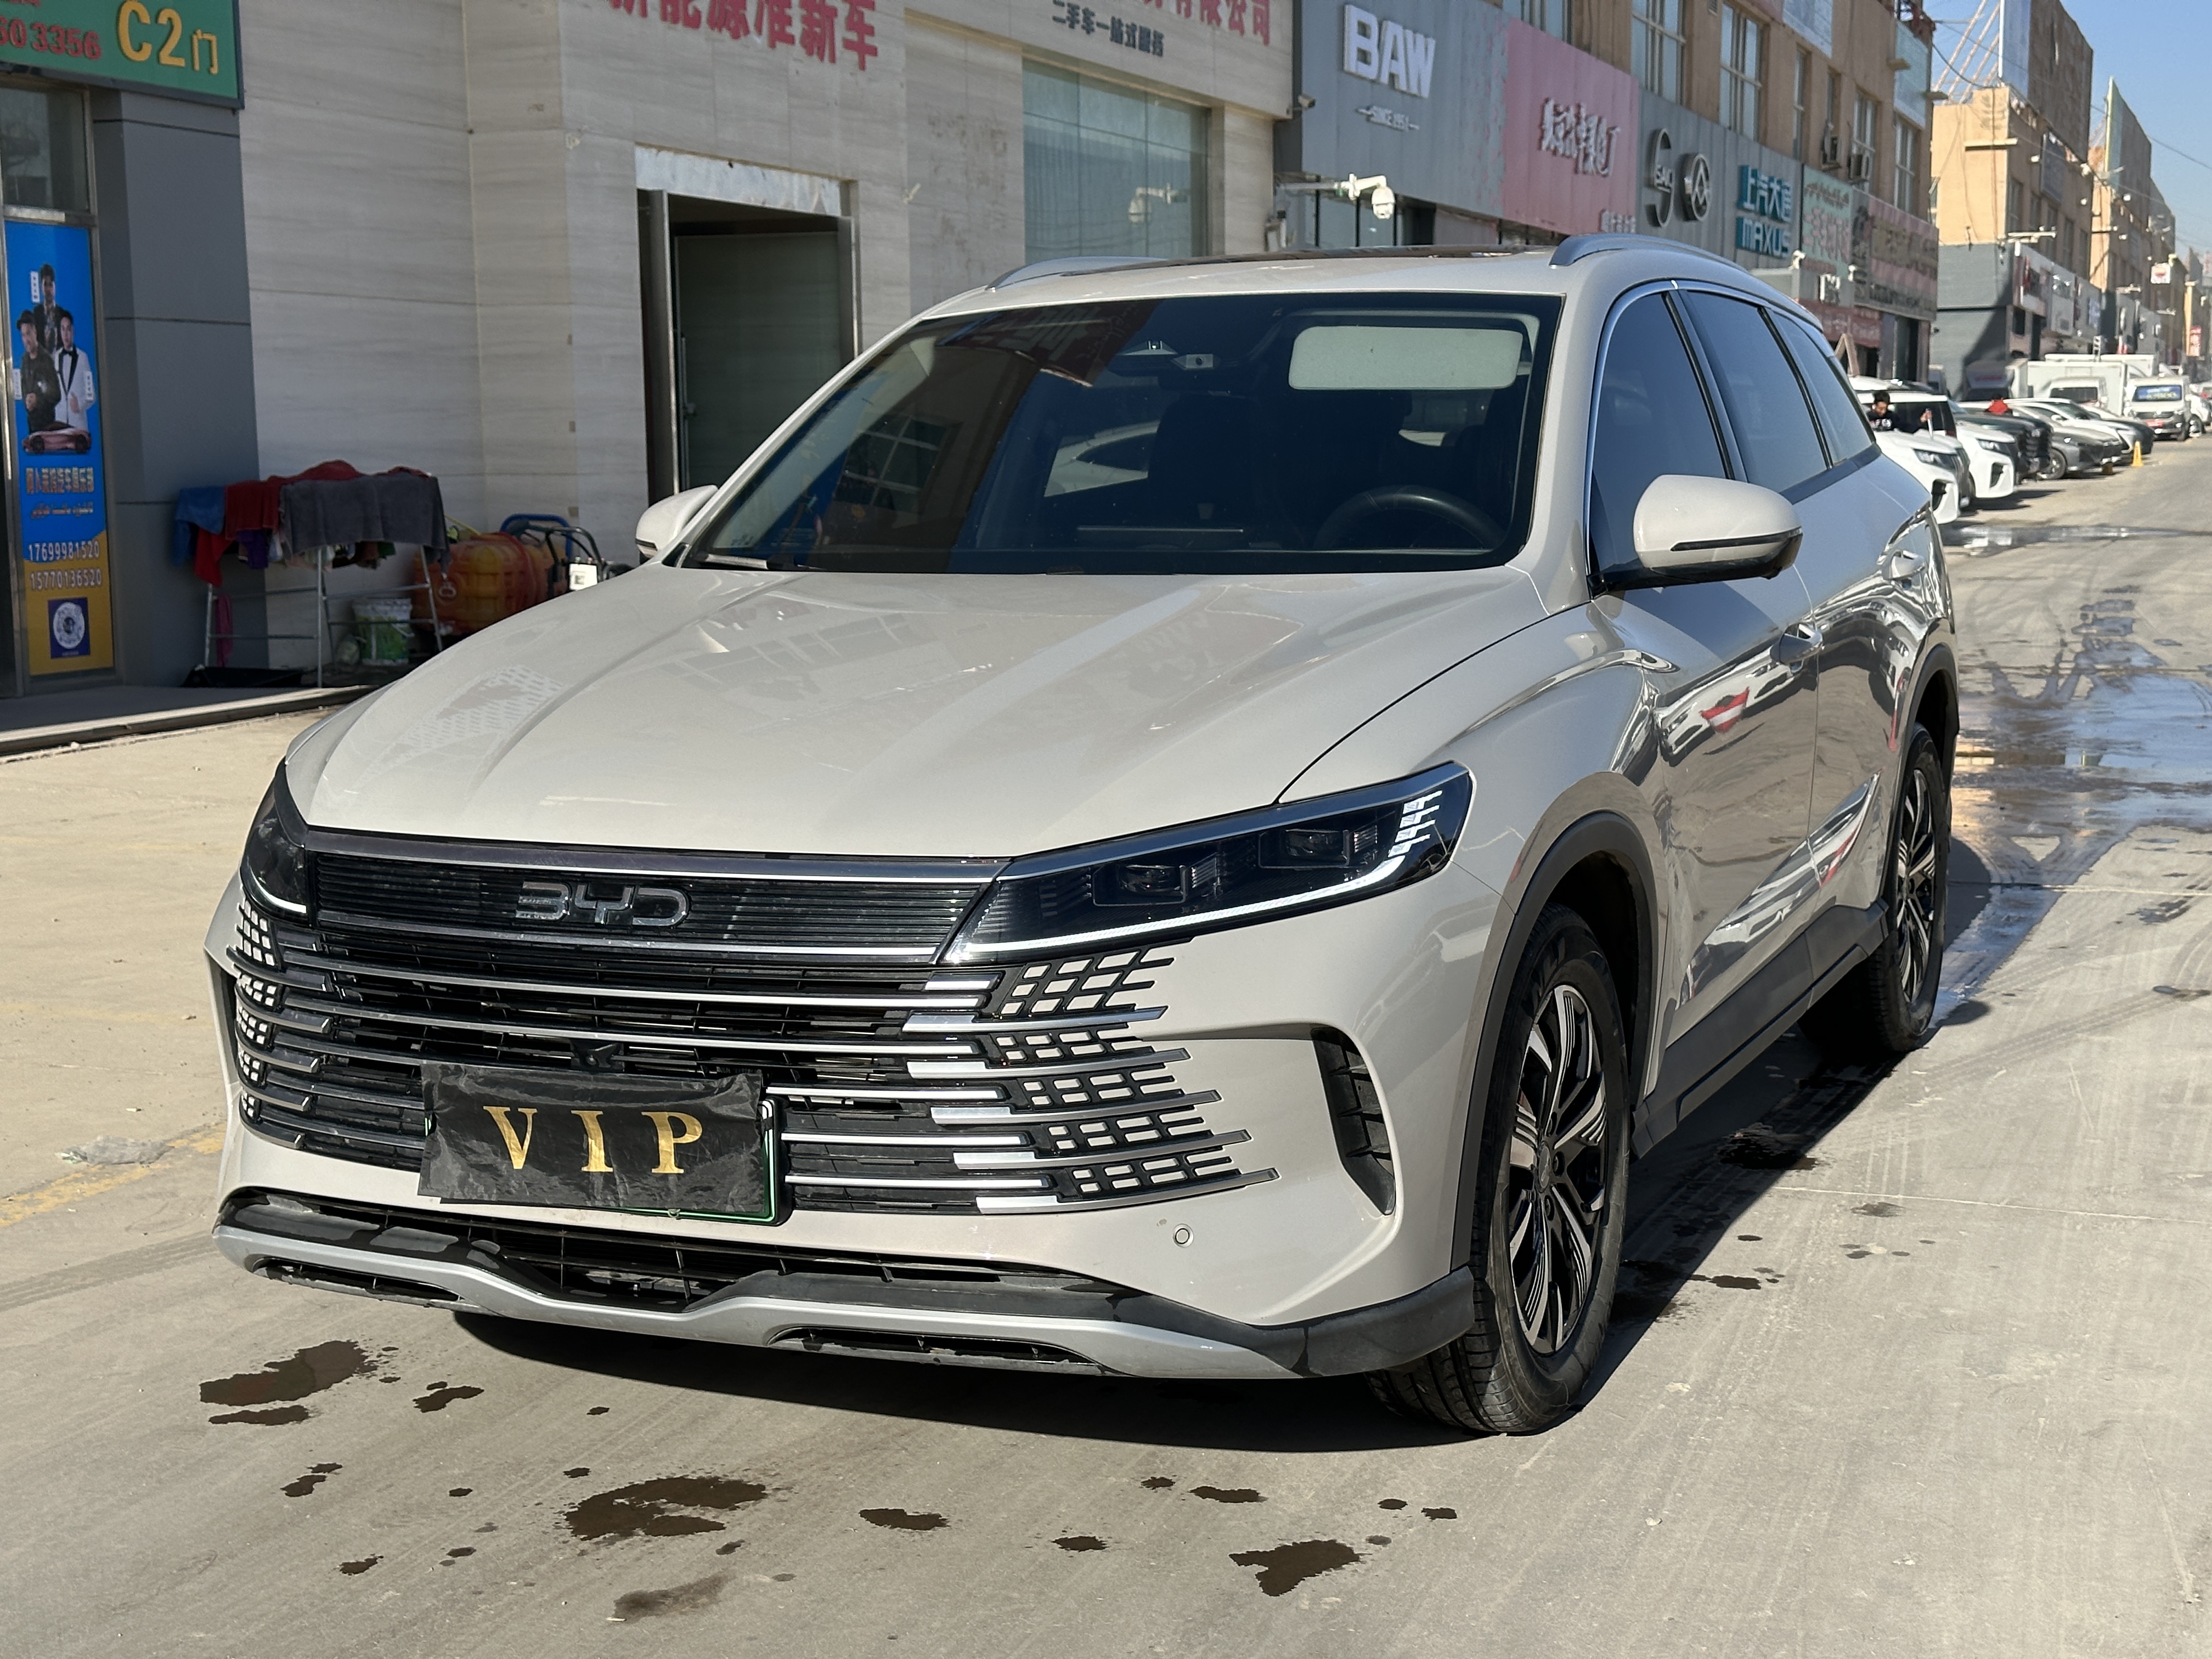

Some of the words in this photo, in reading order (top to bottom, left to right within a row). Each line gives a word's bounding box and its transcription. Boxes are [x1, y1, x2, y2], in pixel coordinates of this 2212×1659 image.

[1344, 4, 1436, 98] BAW
[1741, 217, 1791, 258] MAXUS
[29, 540, 100, 562] 17699981520
[30, 568, 102, 590] 15770136520
[515, 881, 688, 927] BYD
[483, 1105, 703, 1174] VIP
